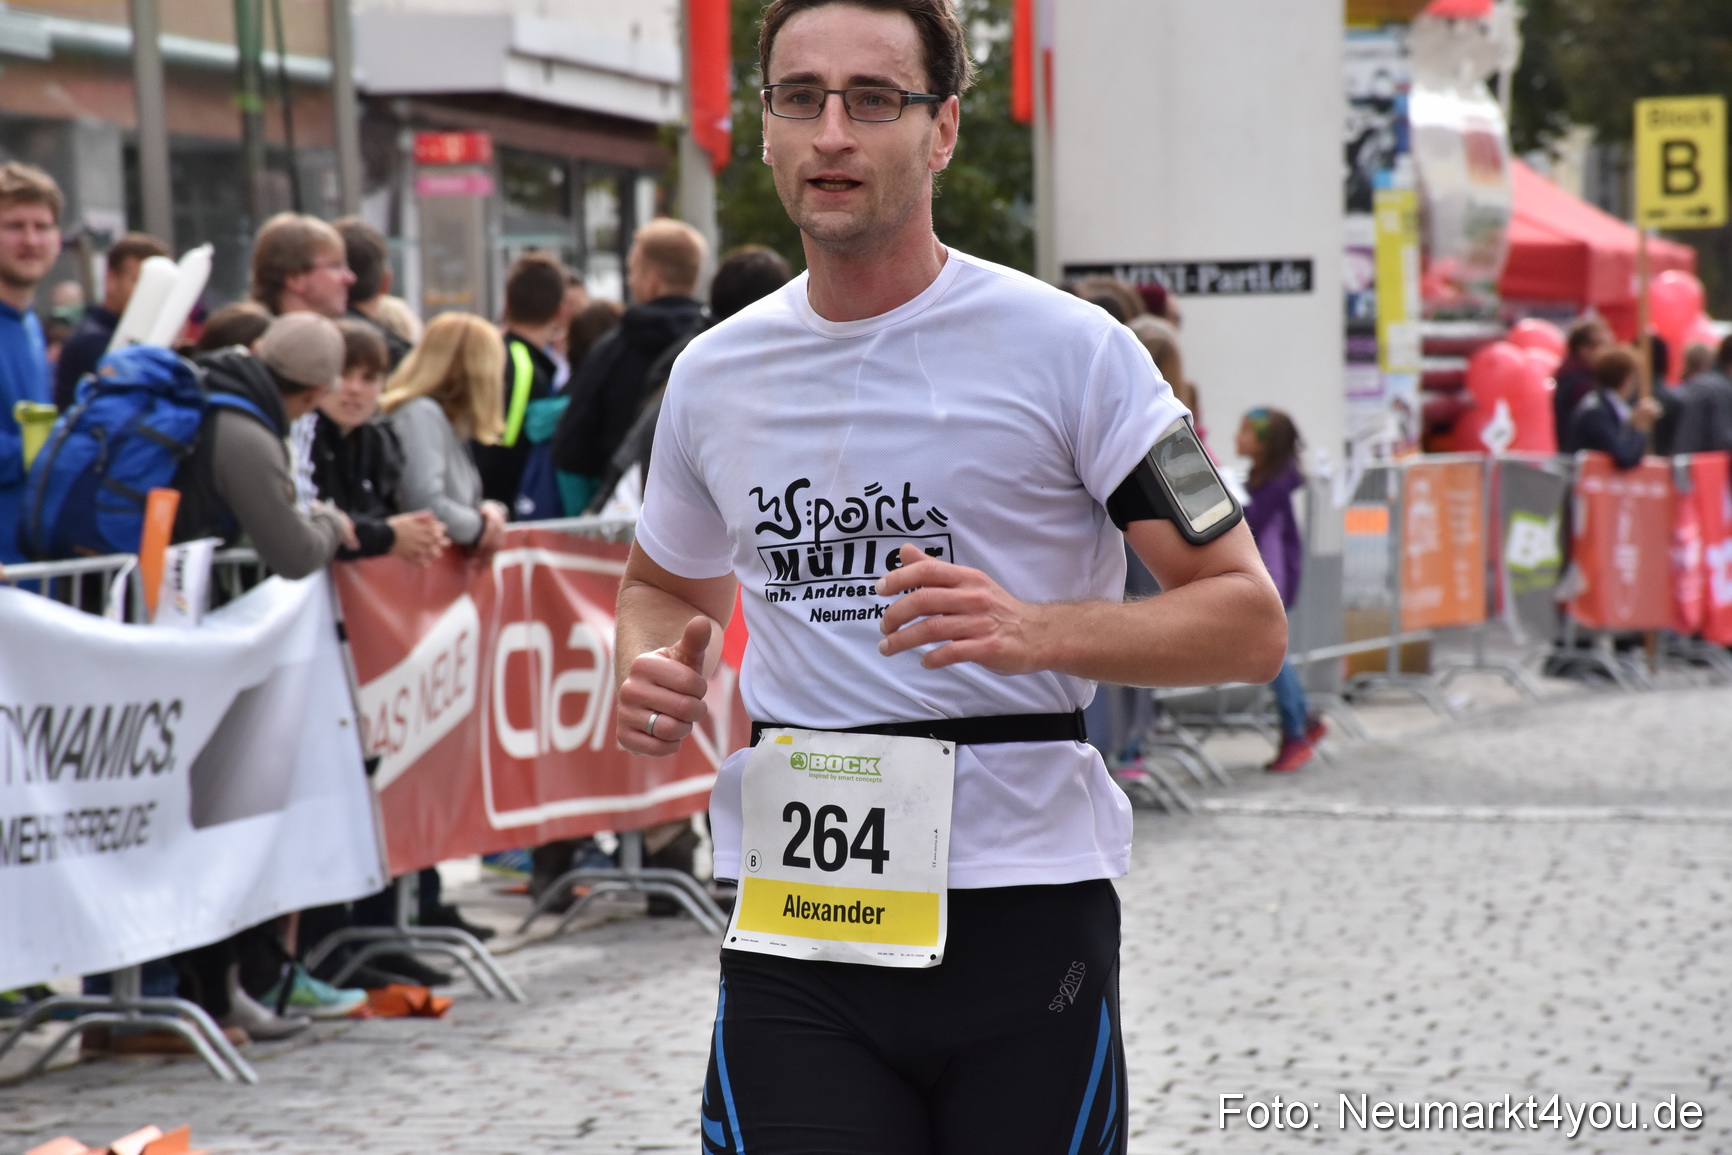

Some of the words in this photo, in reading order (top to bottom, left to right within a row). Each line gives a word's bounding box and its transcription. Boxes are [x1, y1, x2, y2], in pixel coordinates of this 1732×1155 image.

[1661, 139, 1702, 197] B
[755, 478, 926, 551] Sport
[802, 583, 876, 601] Andreas
[809, 603, 890, 623] Neumark
[808, 772, 829, 780] inspired
[809, 753, 881, 776] BOCK
[782, 801, 890, 875] 264
[750, 855, 757, 867] B
[782, 894, 886, 925] Alexander
